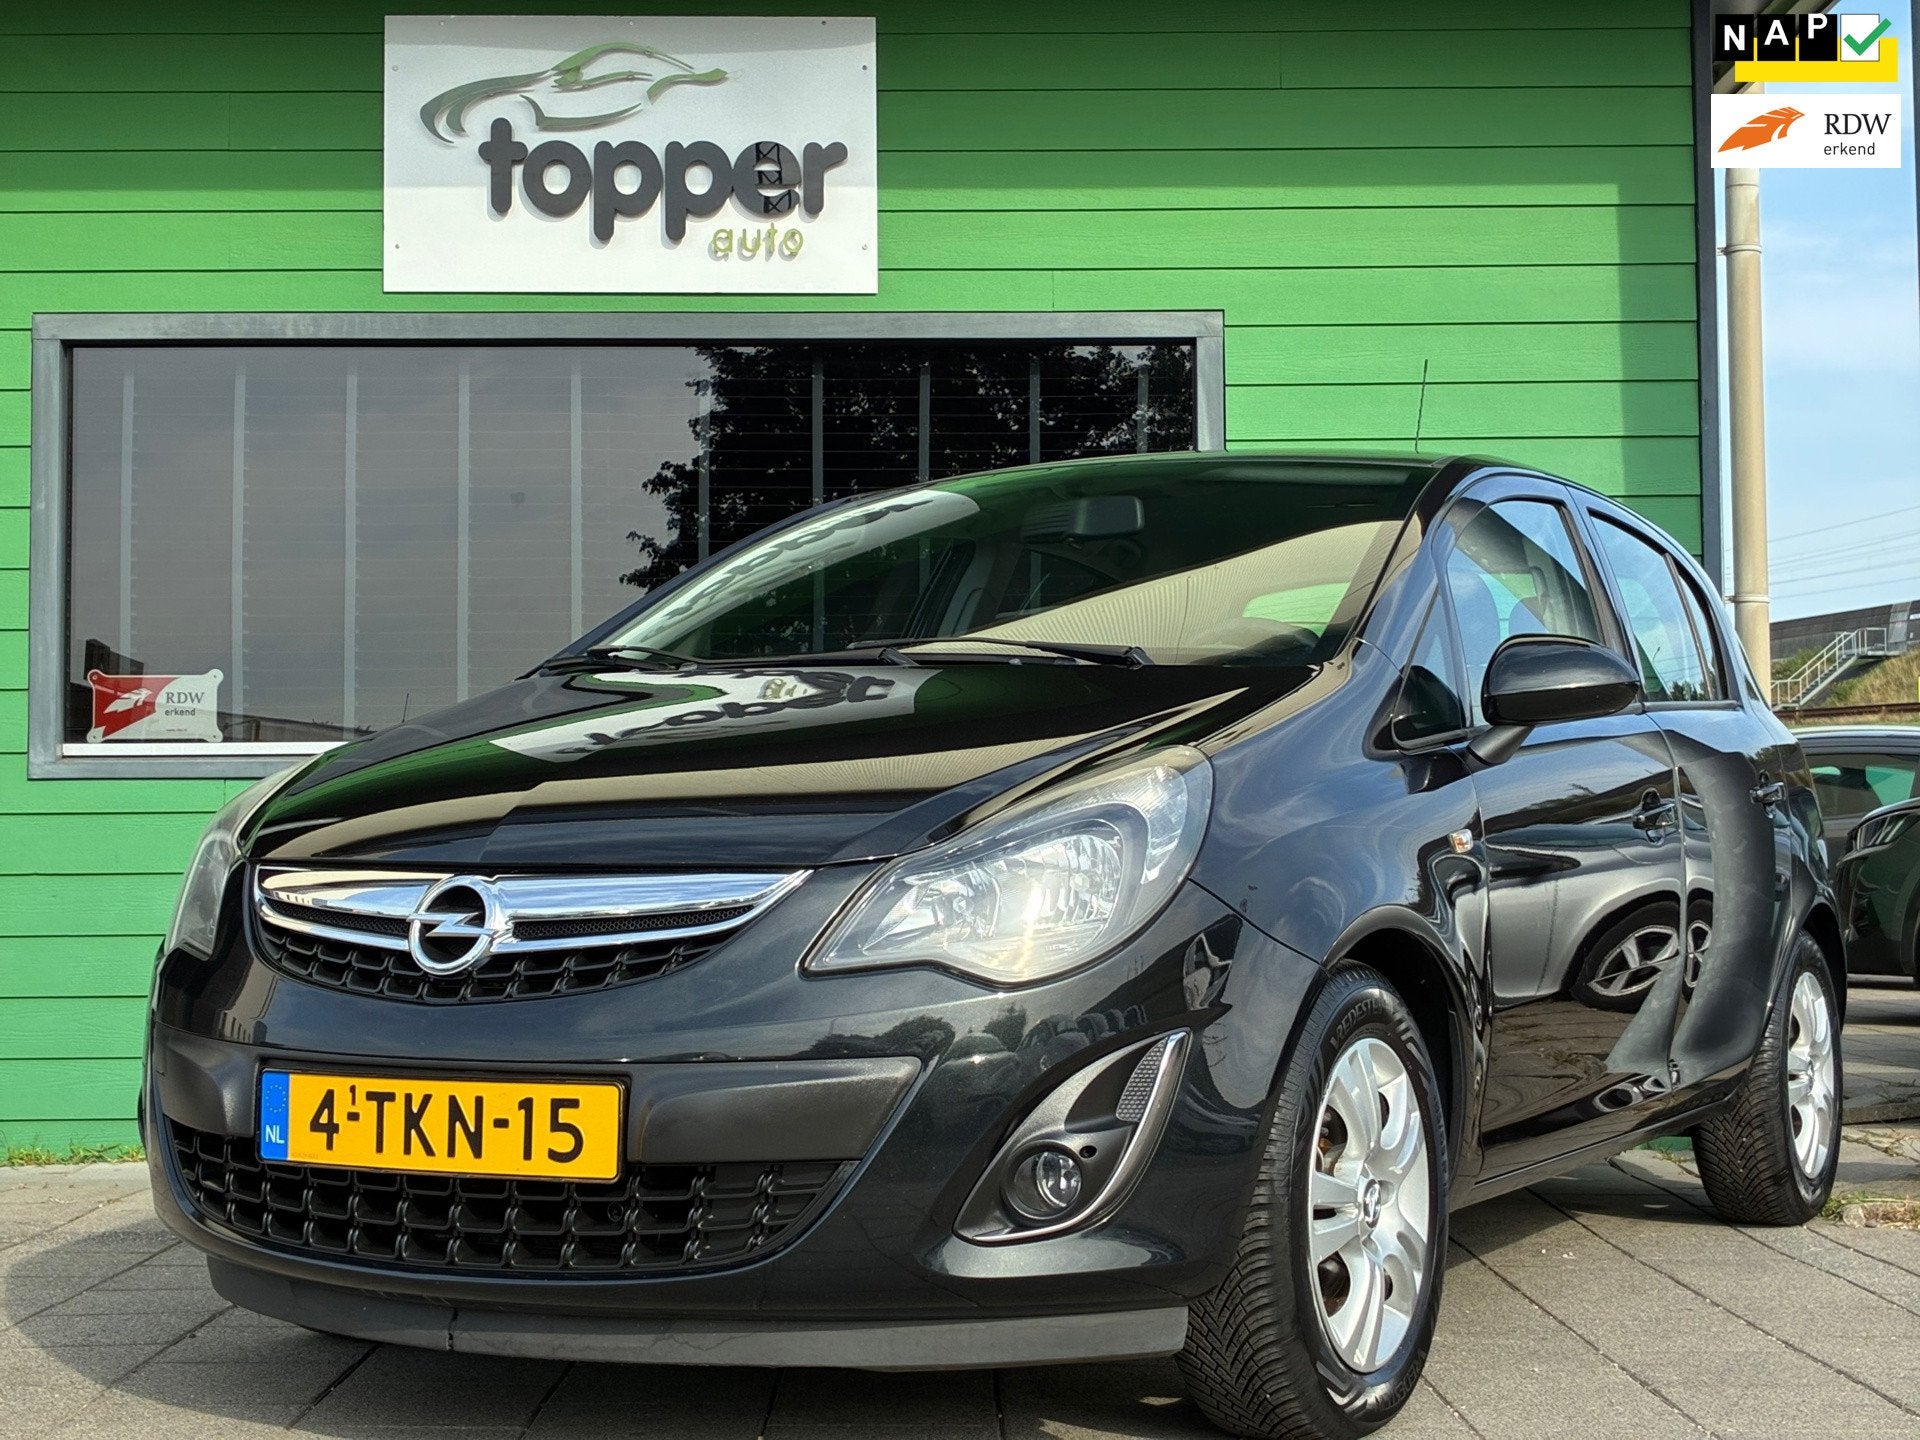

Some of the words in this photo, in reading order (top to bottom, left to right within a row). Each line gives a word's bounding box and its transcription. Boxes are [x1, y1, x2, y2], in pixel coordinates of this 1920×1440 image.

[478, 117, 848, 242] topper
[711, 223, 804, 256] auto
[166, 691, 204, 704] RDW
[165, 708, 196, 716] erkend
[265, 1124, 285, 1144] NL
